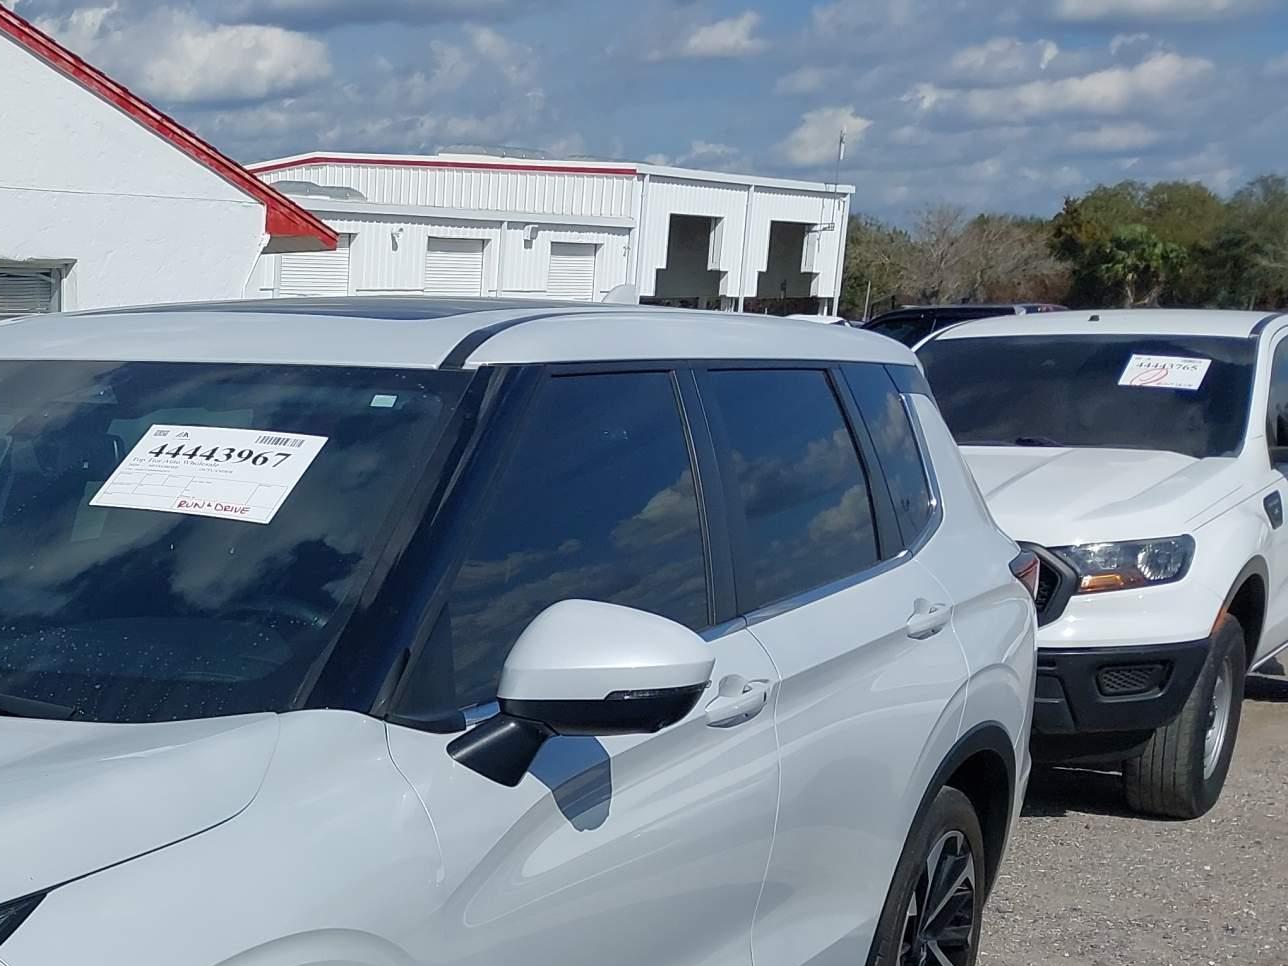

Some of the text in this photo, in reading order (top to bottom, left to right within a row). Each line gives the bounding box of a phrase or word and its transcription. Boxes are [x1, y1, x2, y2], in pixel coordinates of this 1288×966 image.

[148, 443, 292, 468] 44443967
[177, 500, 205, 509] RUN
[214, 503, 251, 515] DRIVE
